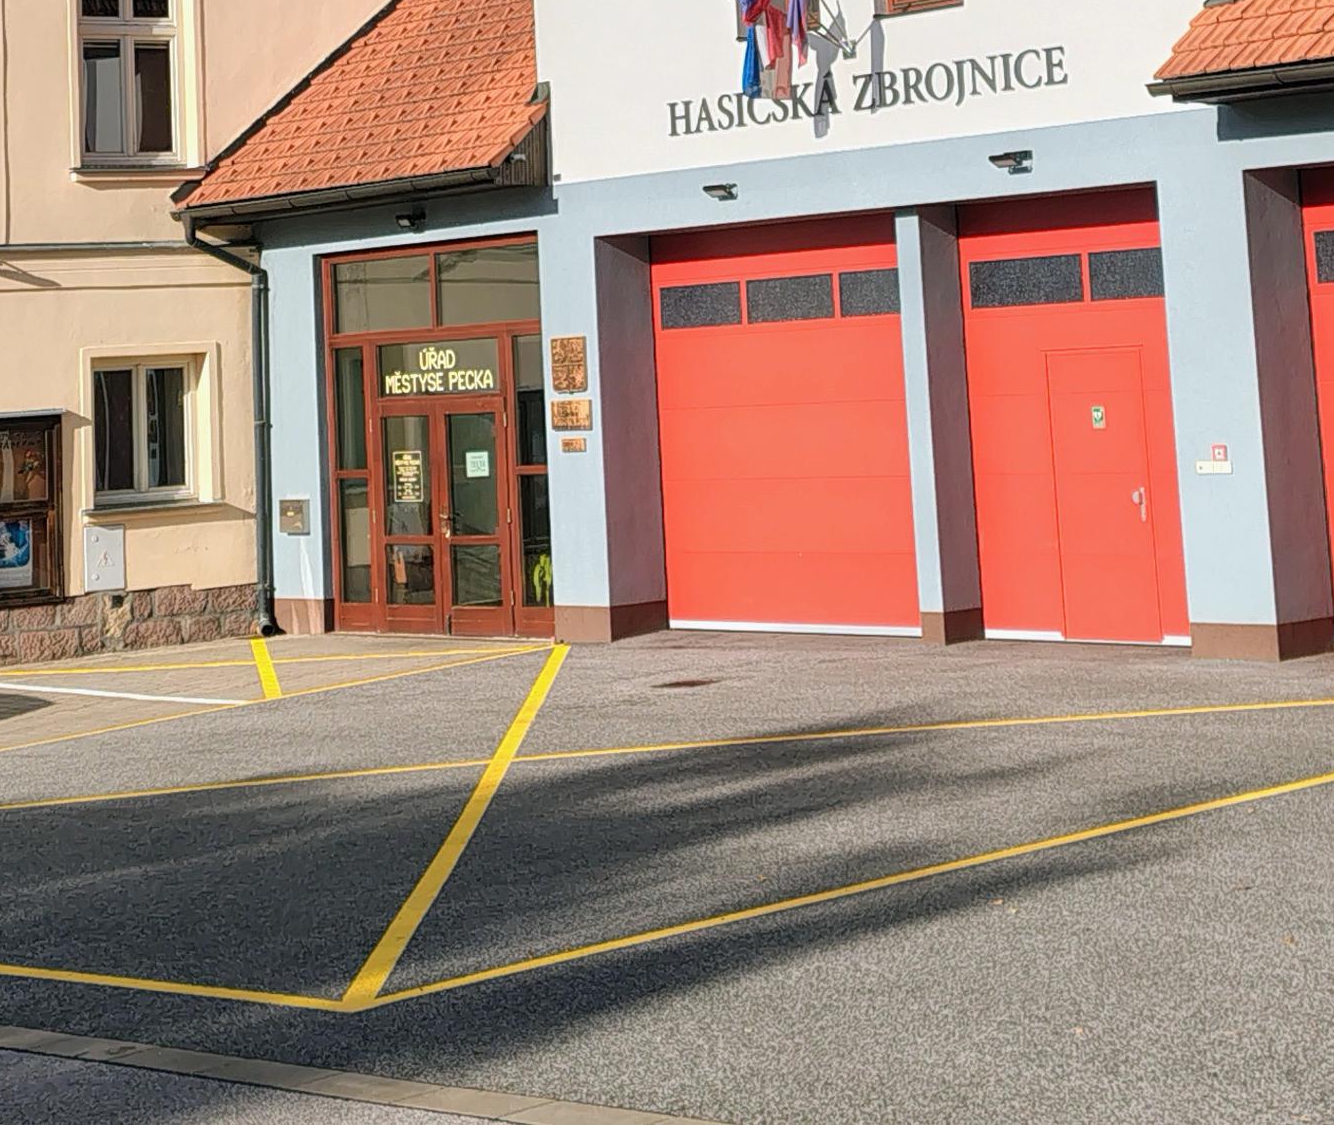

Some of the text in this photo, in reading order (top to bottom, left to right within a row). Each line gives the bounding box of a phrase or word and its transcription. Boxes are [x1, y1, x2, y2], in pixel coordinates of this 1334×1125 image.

[853, 46, 1068, 112] ZBROJNICE
[419, 346, 456, 370] ÚŘAD
[385, 369, 494, 394] MĚSTYSE PECKA
